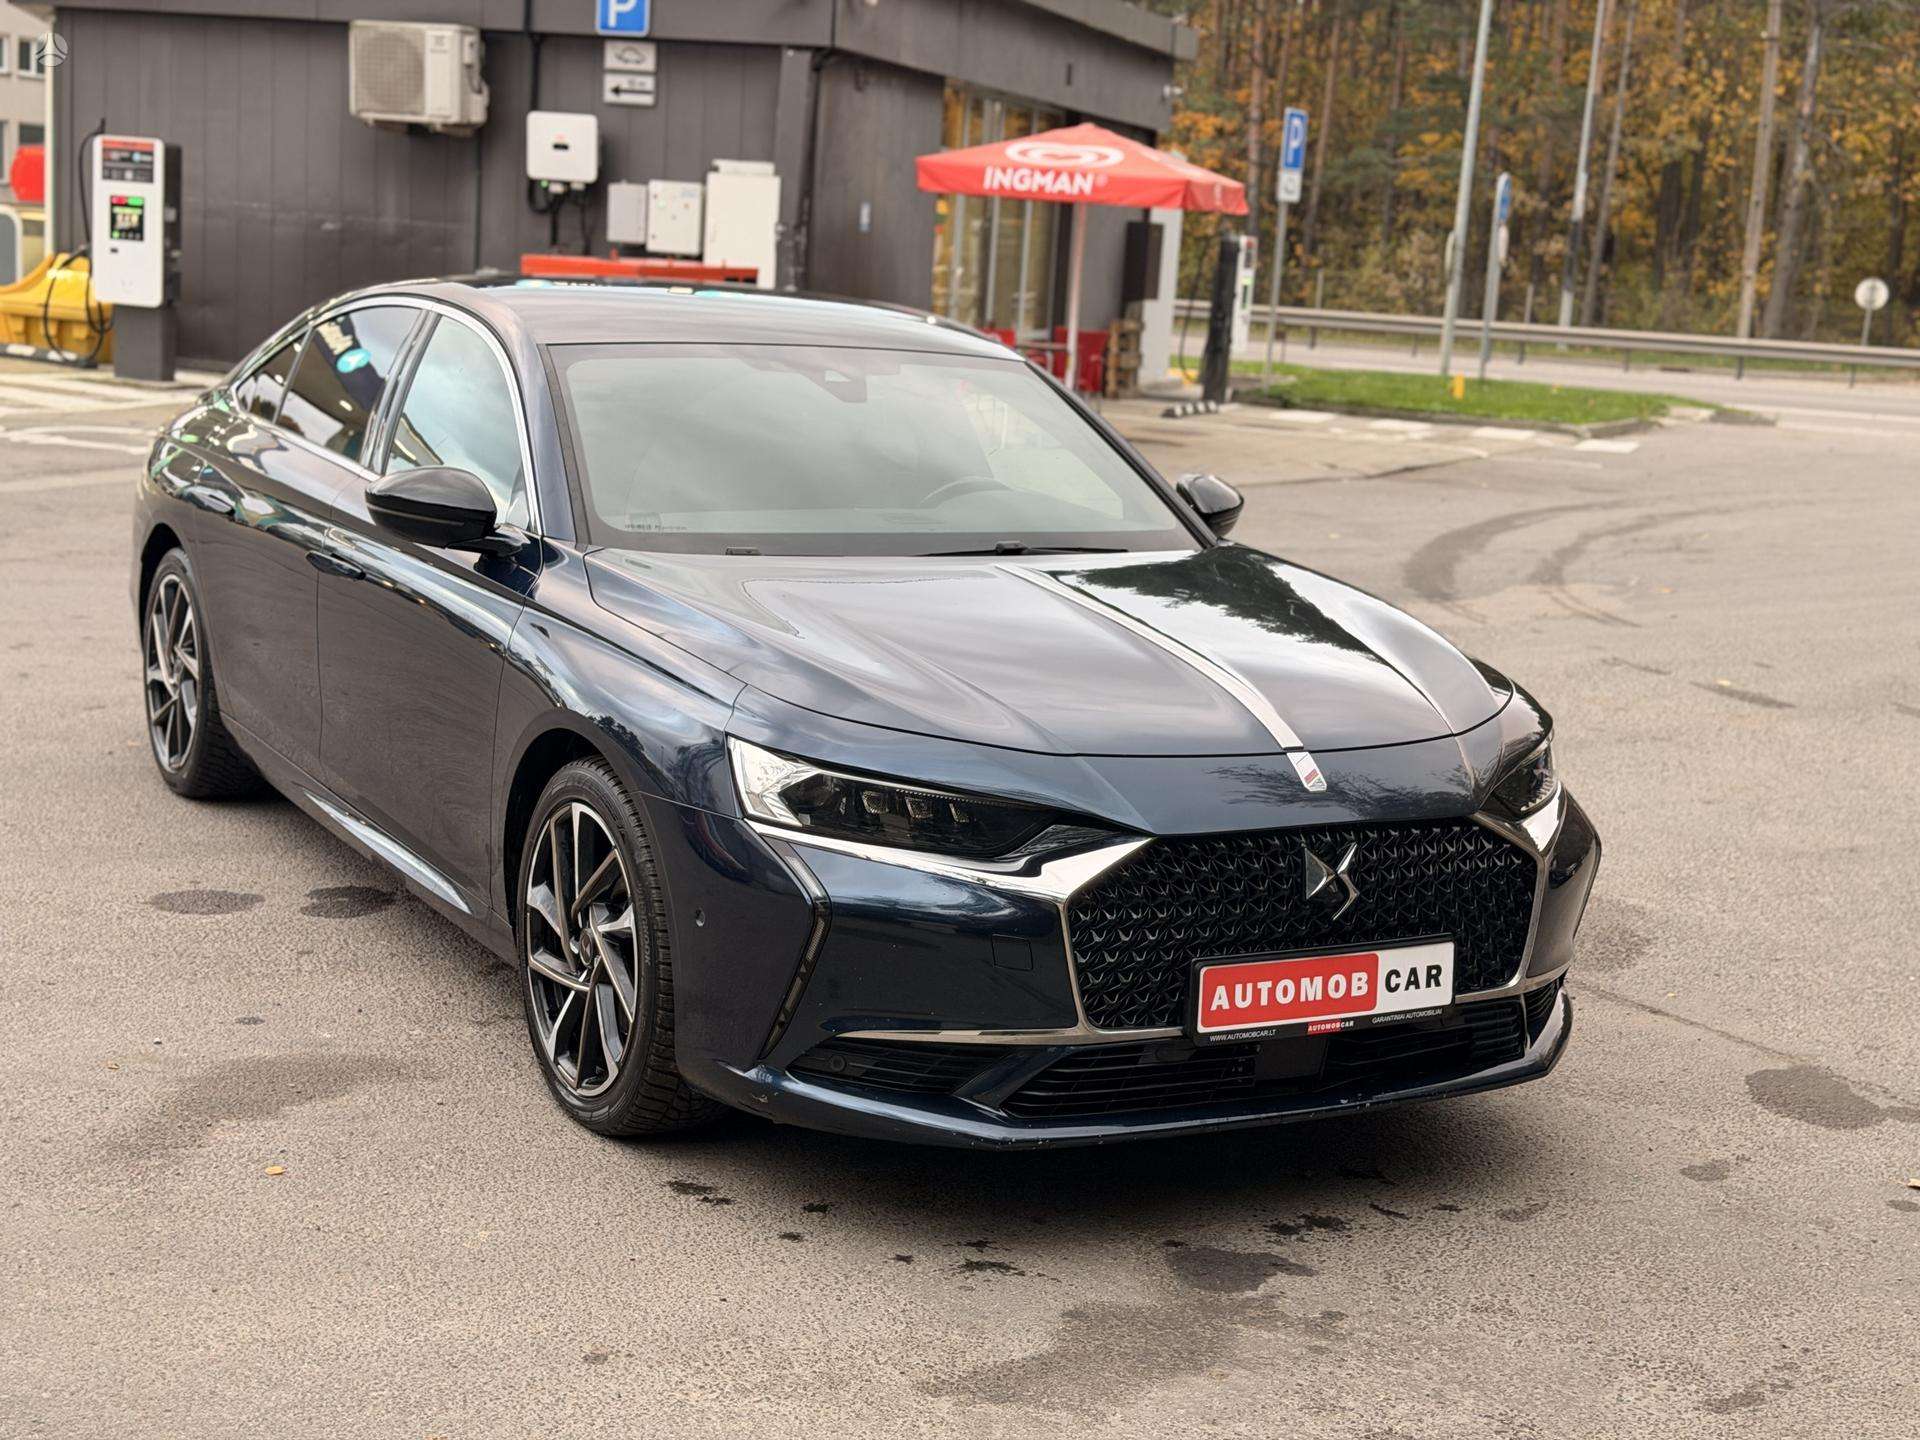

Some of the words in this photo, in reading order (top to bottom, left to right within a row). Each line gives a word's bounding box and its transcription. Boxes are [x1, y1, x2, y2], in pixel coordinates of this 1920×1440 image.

[1286, 117, 1304, 164] P
[983, 166, 1094, 195] INGMAN
[1210, 971, 1369, 1011] AUTOMOB
[1384, 964, 1443, 993] CAR
[1209, 1029, 1277, 1042] WWW.AUTOMOBCAR.LT
